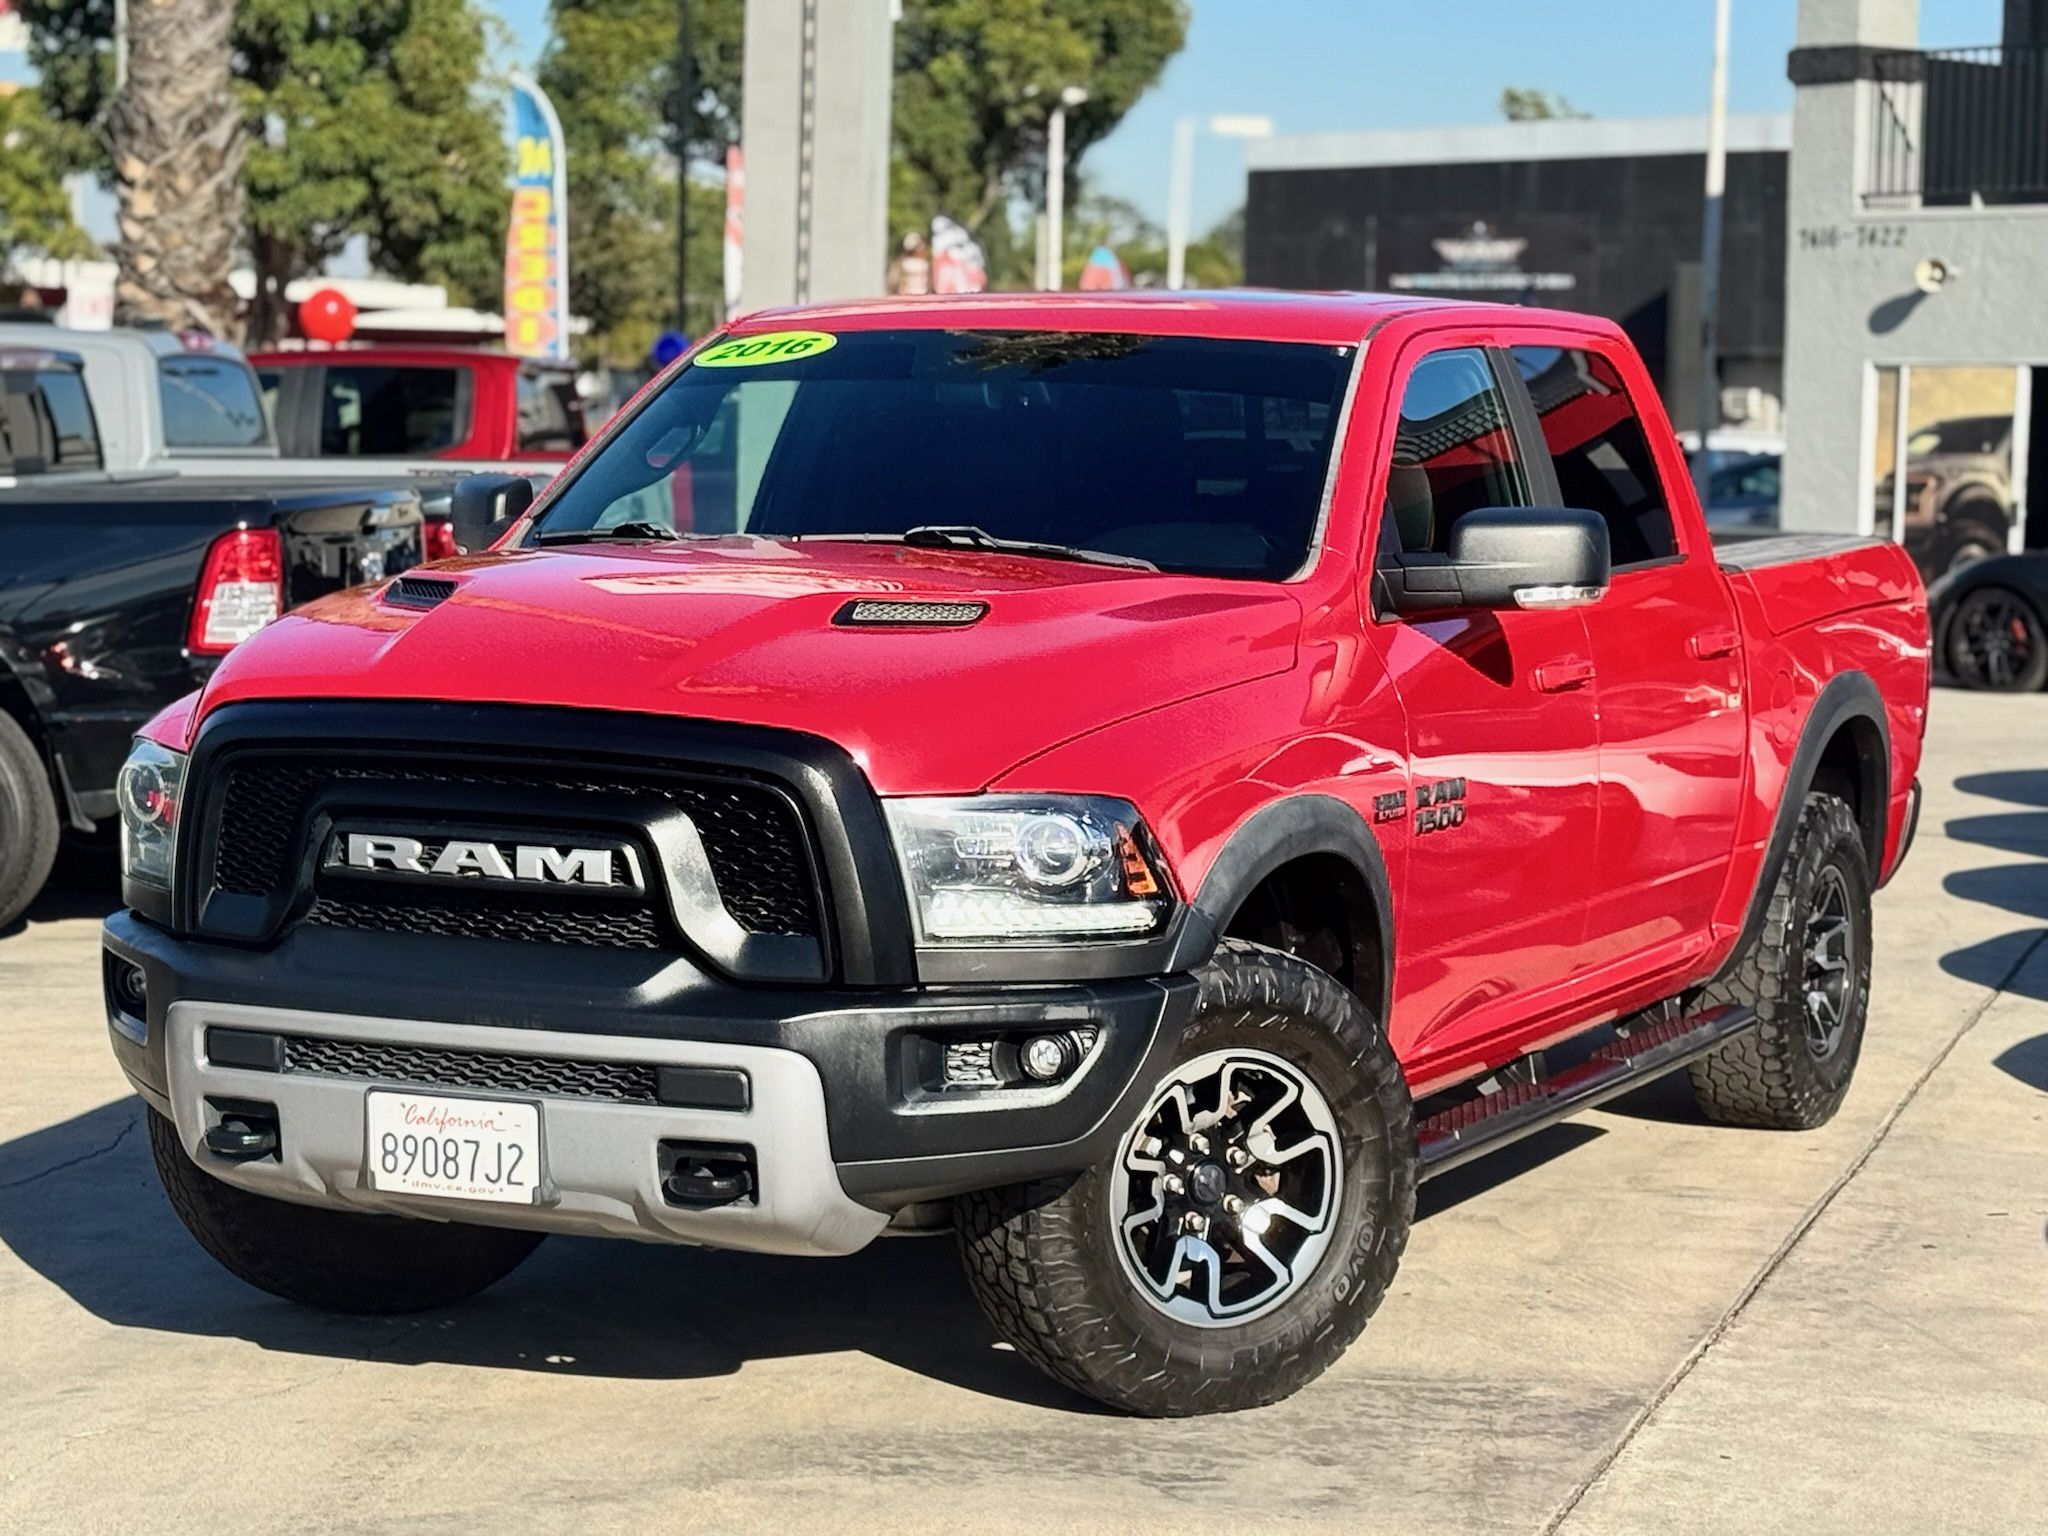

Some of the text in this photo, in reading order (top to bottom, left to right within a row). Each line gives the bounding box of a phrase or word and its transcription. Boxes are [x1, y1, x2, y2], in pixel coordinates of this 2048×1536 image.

[706, 337, 822, 362] 2016
[1414, 777, 1466, 809] RAM
[1415, 803, 1466, 836] 1500
[348, 833, 613, 886] RAM
[404, 1103, 507, 1134] California
[381, 1132, 525, 1186] 89087J2
